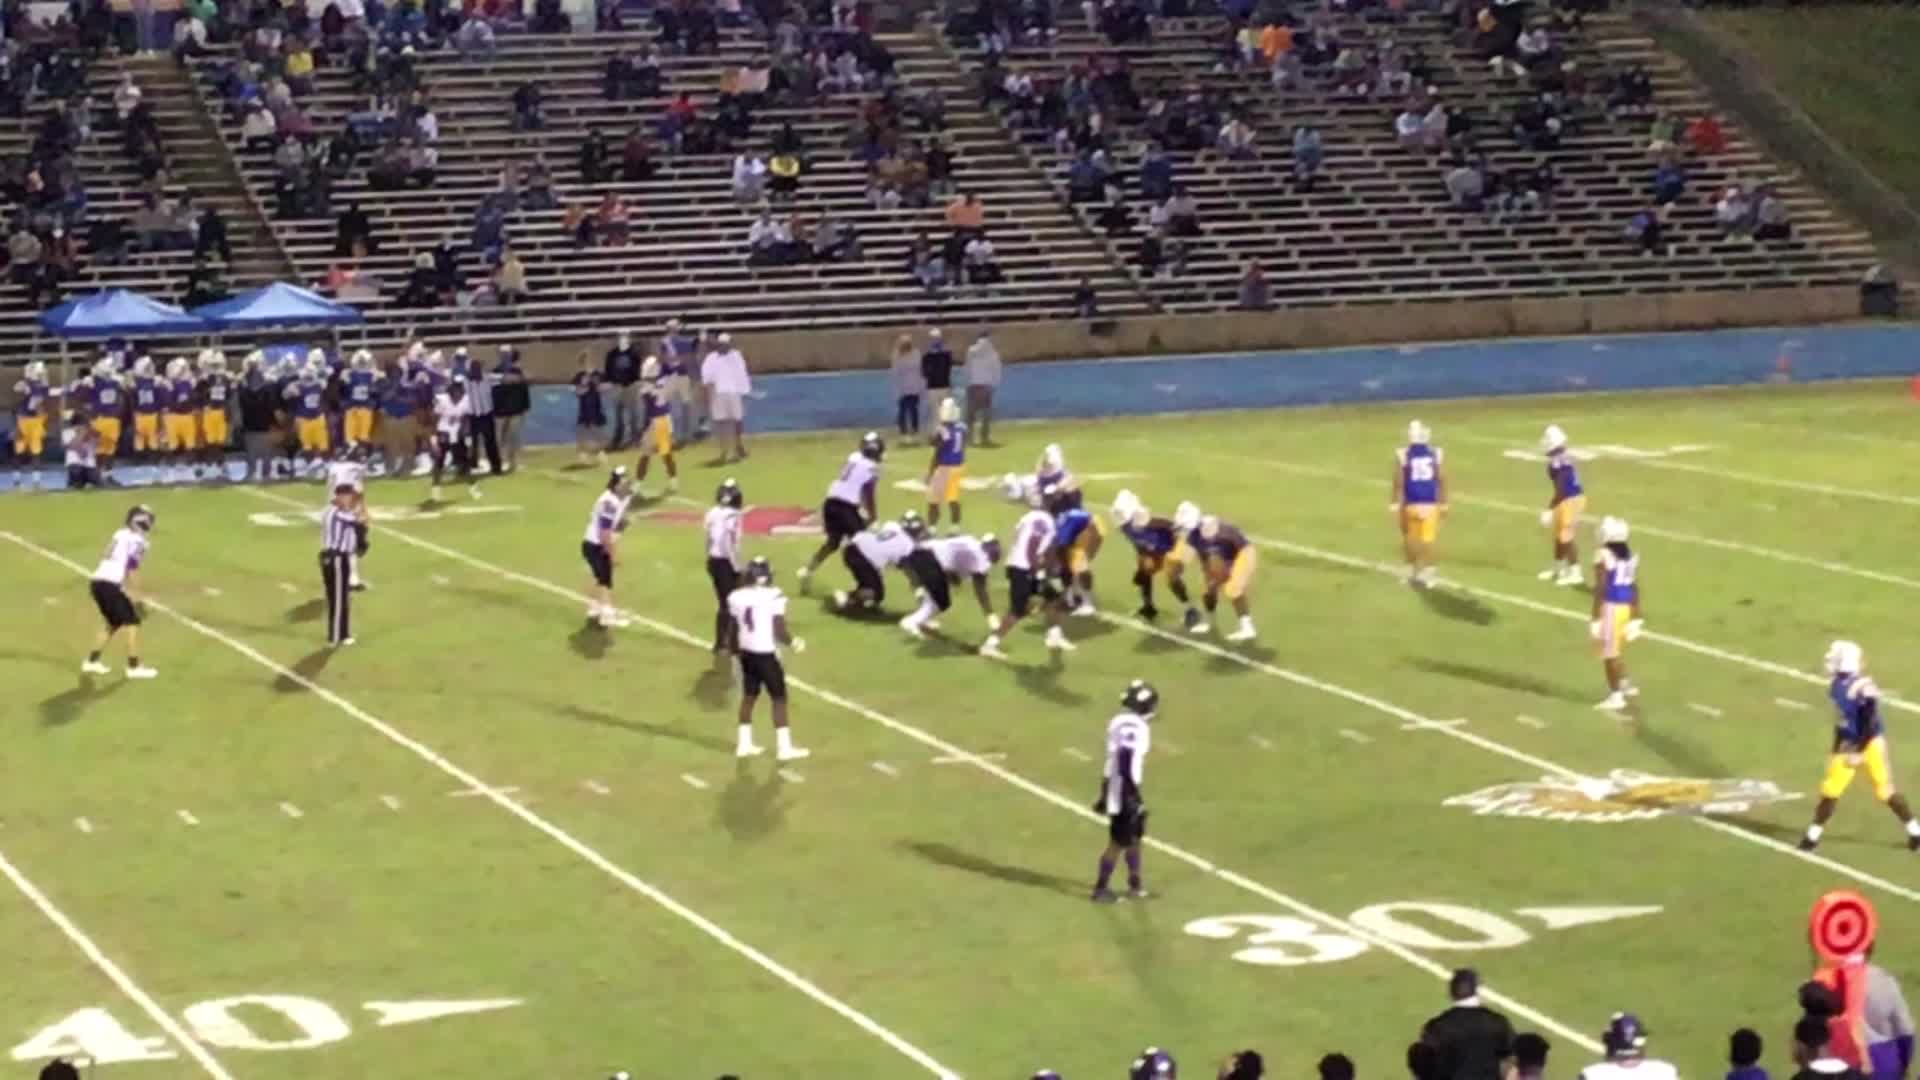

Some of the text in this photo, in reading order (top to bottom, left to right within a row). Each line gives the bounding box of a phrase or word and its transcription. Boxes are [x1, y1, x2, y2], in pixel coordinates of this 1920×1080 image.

[1410, 456, 1434, 481] 15
[742, 605, 756, 633] 4
[1183, 902, 1531, 965] 30
[11, 995, 350, 1067] 40
